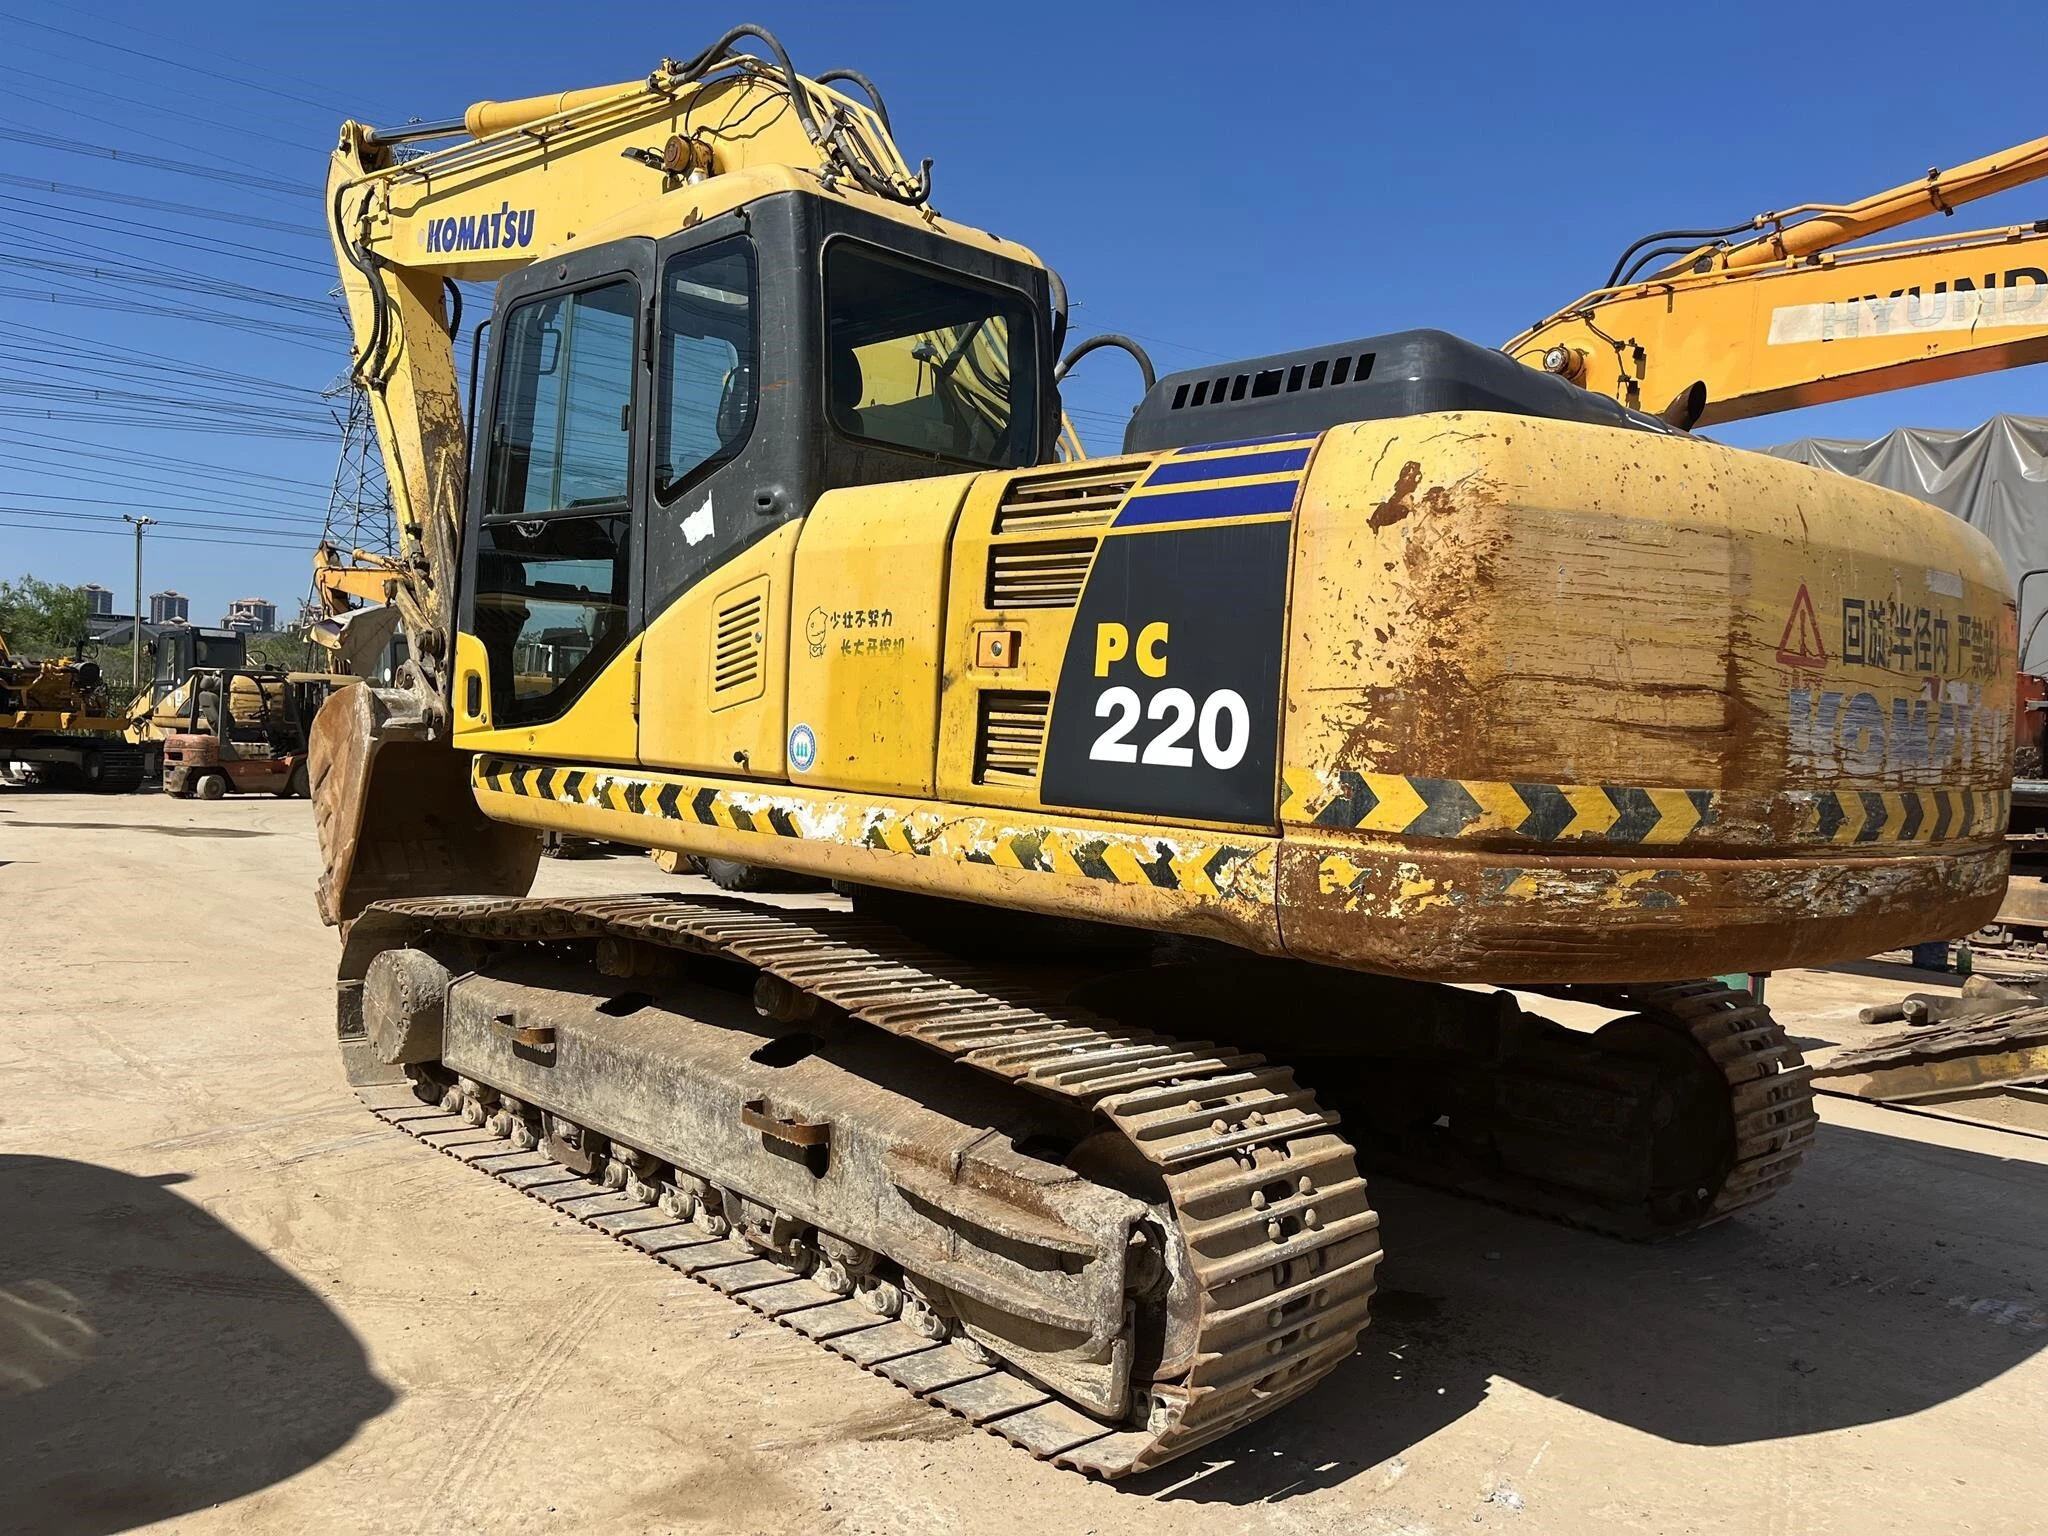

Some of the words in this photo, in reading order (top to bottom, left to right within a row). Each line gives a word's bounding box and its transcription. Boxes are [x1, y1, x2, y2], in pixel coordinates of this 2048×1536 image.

[426, 201, 536, 254] KOMATSU
[830, 608, 893, 629] 少壮不努力
[841, 637, 905, 657] 长大开挖机
[1094, 621, 1169, 678] PC
[1089, 685, 1250, 770] 220
